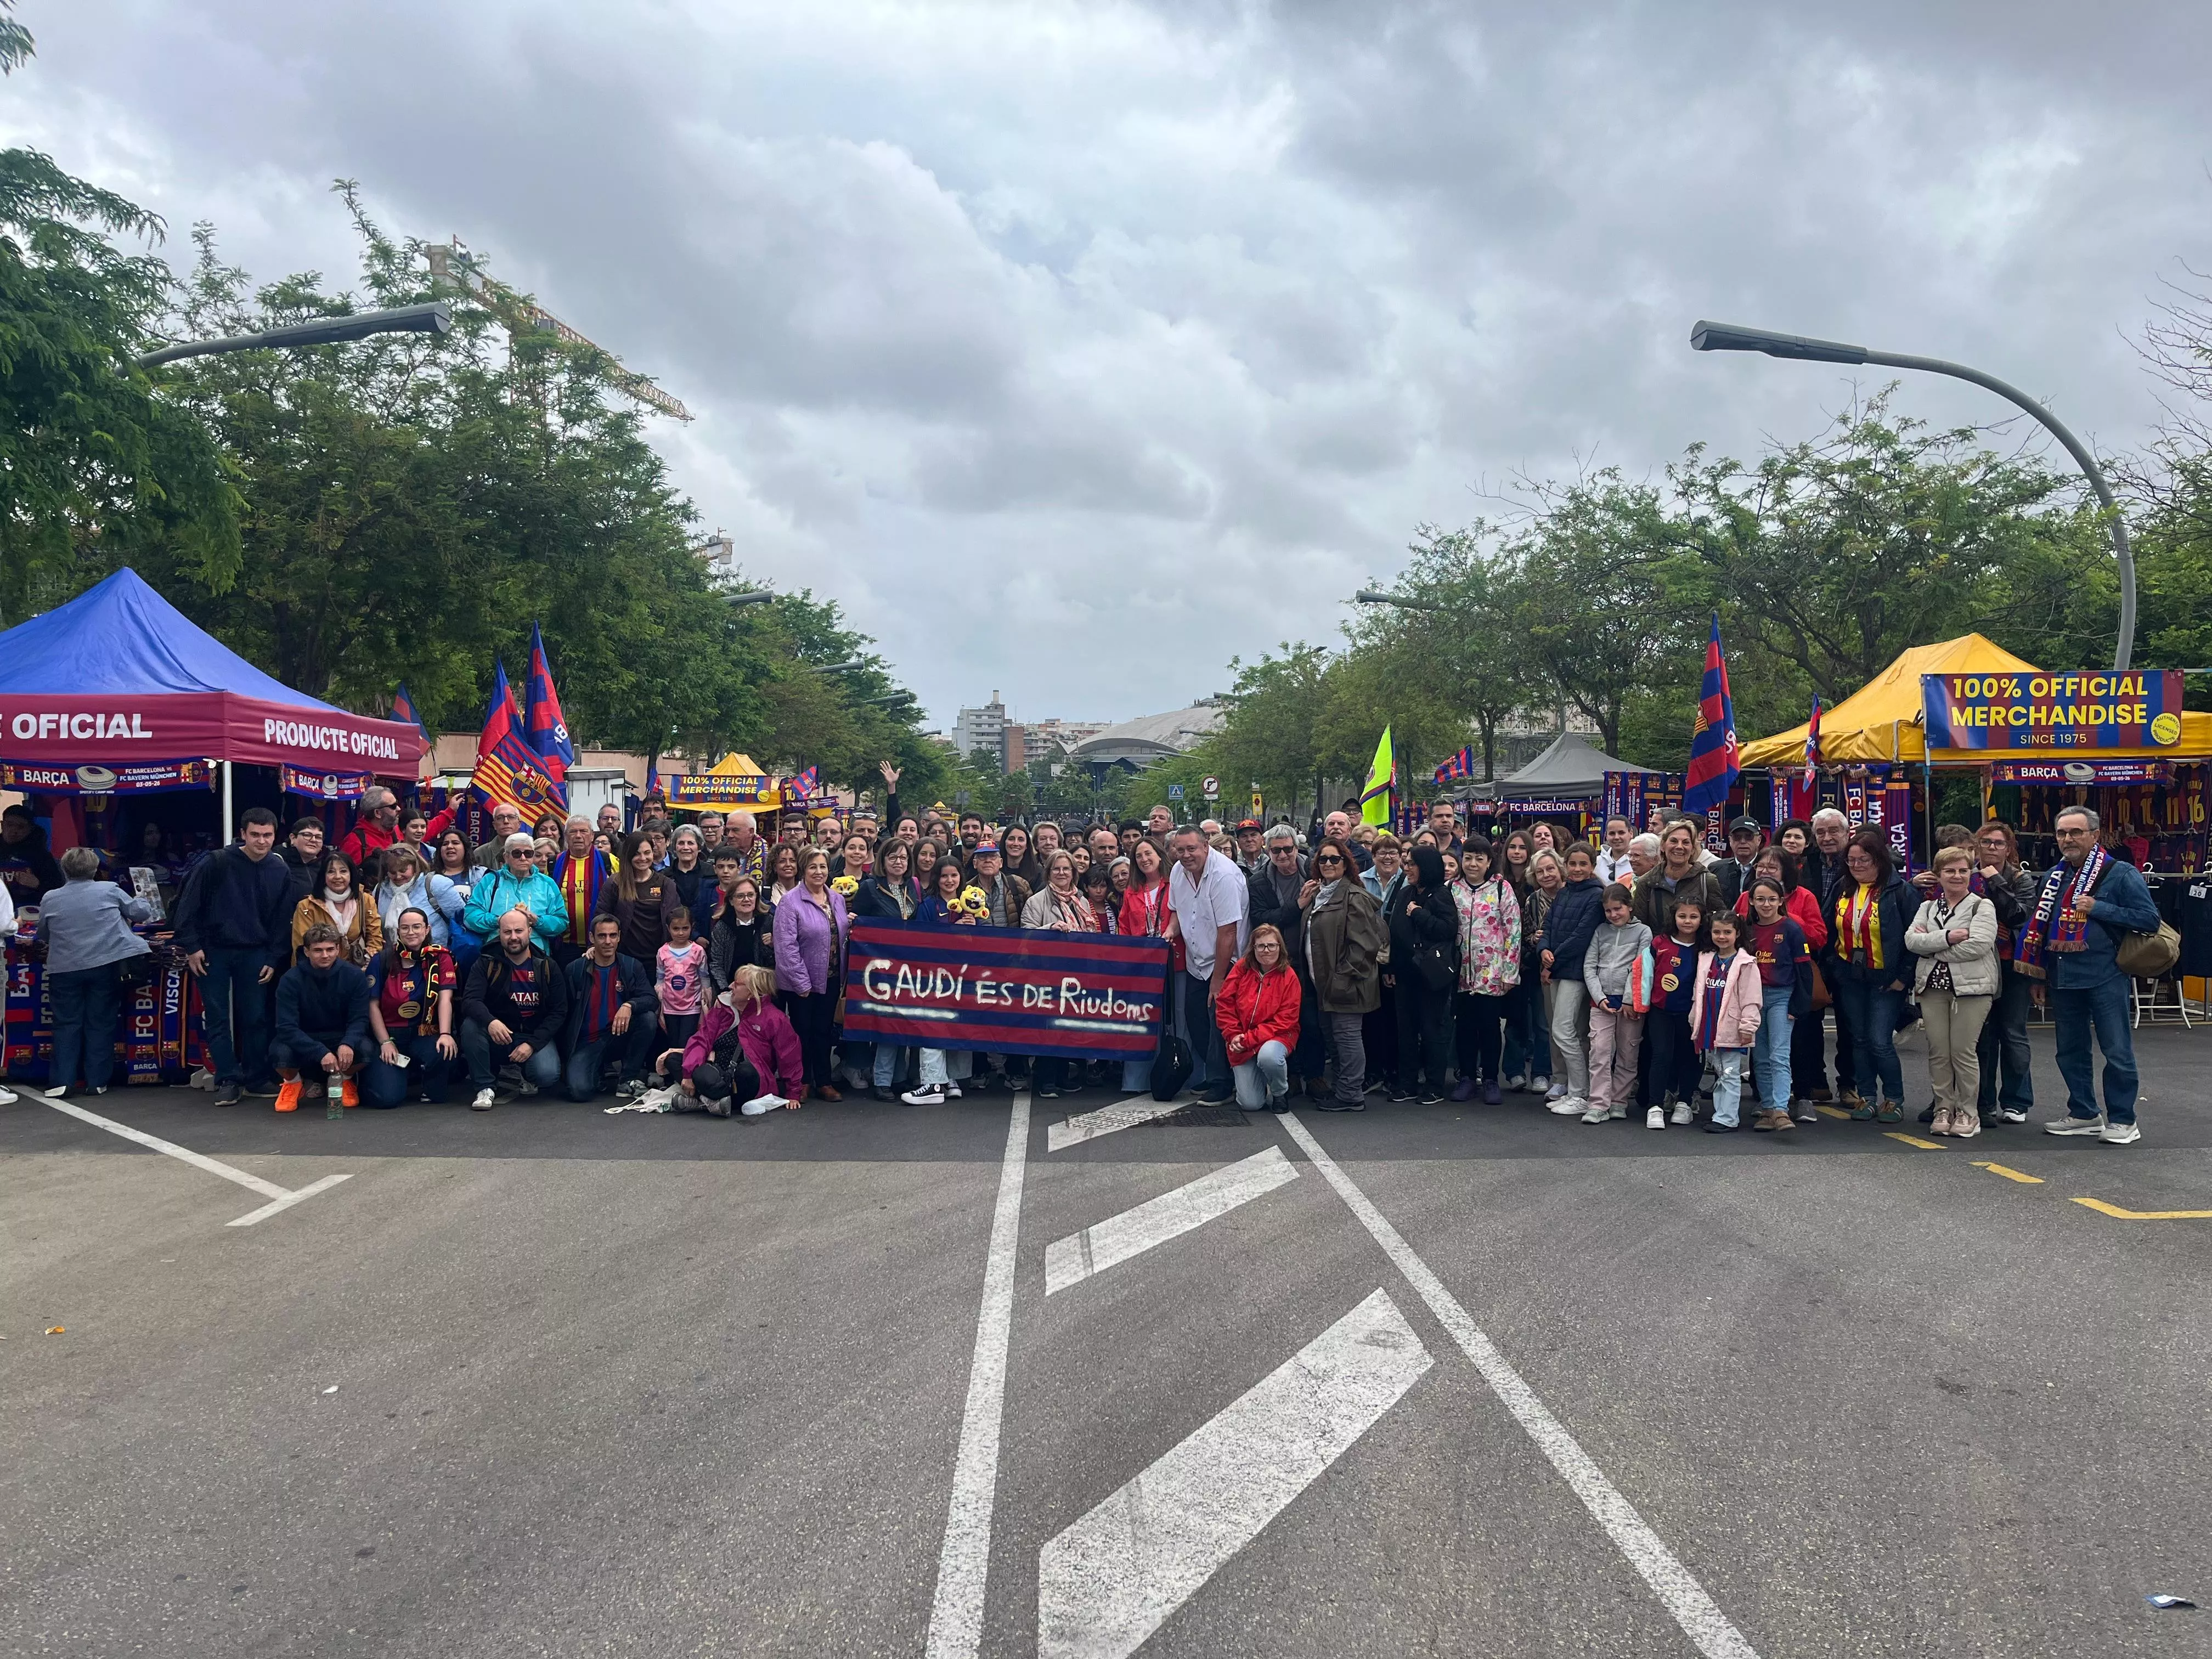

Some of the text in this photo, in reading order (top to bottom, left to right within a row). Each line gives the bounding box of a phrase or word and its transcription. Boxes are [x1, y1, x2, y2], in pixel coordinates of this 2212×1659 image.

[1953, 676, 2148, 698] 100% OFFICIAL
[12, 713, 153, 739] OFICIAL
[1951, 704, 2148, 726] MERCHANDISE
[265, 718, 399, 760] PRODUCTE OFICIAL
[2020, 733, 2087, 744] SINCE 1975
[2154, 723, 2178, 735] LICENSED
[23, 770, 70, 786] BARÇA
[298, 774, 319, 791] BARÇA
[2021, 768, 2058, 779] BARÇA
[1510, 803, 1576, 811] FC BARCELONA
[1848, 788, 1861, 806] FC
[2187, 795, 2205, 823] 16
[470, 811, 480, 848] BARÇA
[1707, 810, 1719, 854] BARCEL
[1588, 833, 1600, 850] 11
[2081, 850, 2095, 874] BAYERN
[2084, 858, 2103, 892] BARCELONA
[165, 969, 180, 1014] VISCA
[510, 992, 539, 1002] ATAR
[864, 959, 1154, 1022] GAUDÍ ÉS DE Riudoms
[136, 979, 154, 1037] FC BA
